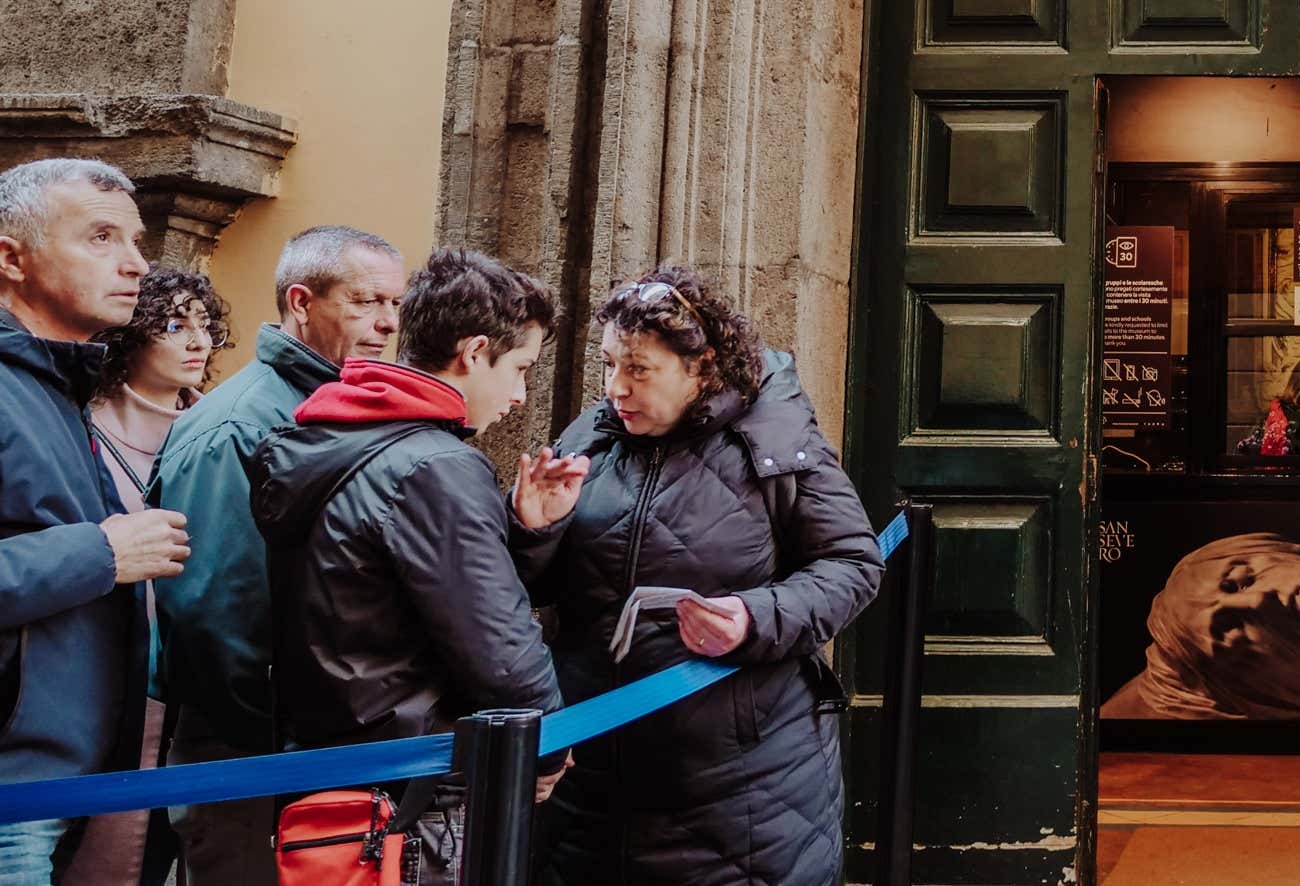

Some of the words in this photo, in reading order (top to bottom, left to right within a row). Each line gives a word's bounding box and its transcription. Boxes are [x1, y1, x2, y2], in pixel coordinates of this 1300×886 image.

[1120, 252, 1133, 261] 30
[1099, 520, 1128, 534] SAN
[1099, 534, 1135, 547] SEVE
[1099, 547, 1121, 563] RO
